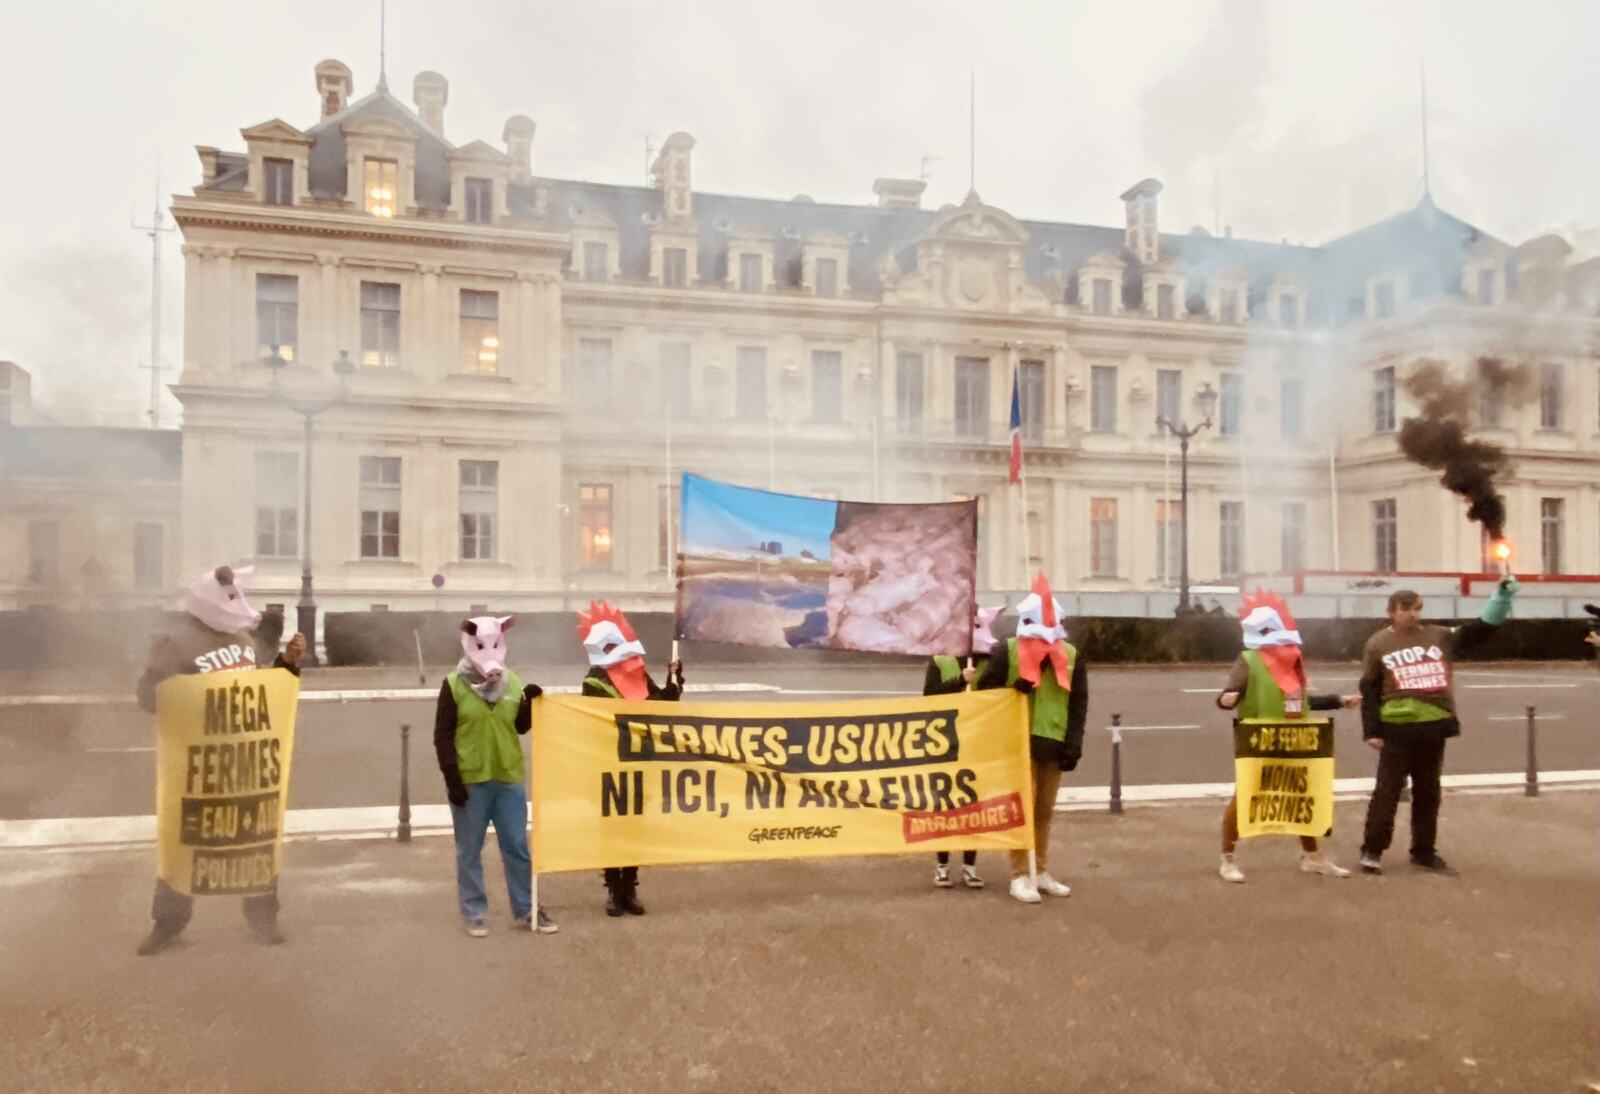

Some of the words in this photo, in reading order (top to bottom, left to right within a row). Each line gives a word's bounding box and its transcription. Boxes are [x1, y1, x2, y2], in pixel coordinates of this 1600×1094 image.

[195, 644, 242, 673] STOP
[1382, 646, 1425, 670] STOP
[1393, 661, 1446, 680] FERMES
[204, 680, 271, 736] MÉGA
[626, 718, 950, 766] FERMES-USINES
[186, 738, 281, 794] FERMES
[1260, 765, 1308, 793] MOINS
[601, 770, 644, 817] NI
[661, 768, 730, 818] ICI,
[745, 771, 786, 810] NI
[798, 768, 979, 812] AILLEURS
[201, 804, 239, 839] EAU
[748, 825, 842, 843] GREENPEACE
